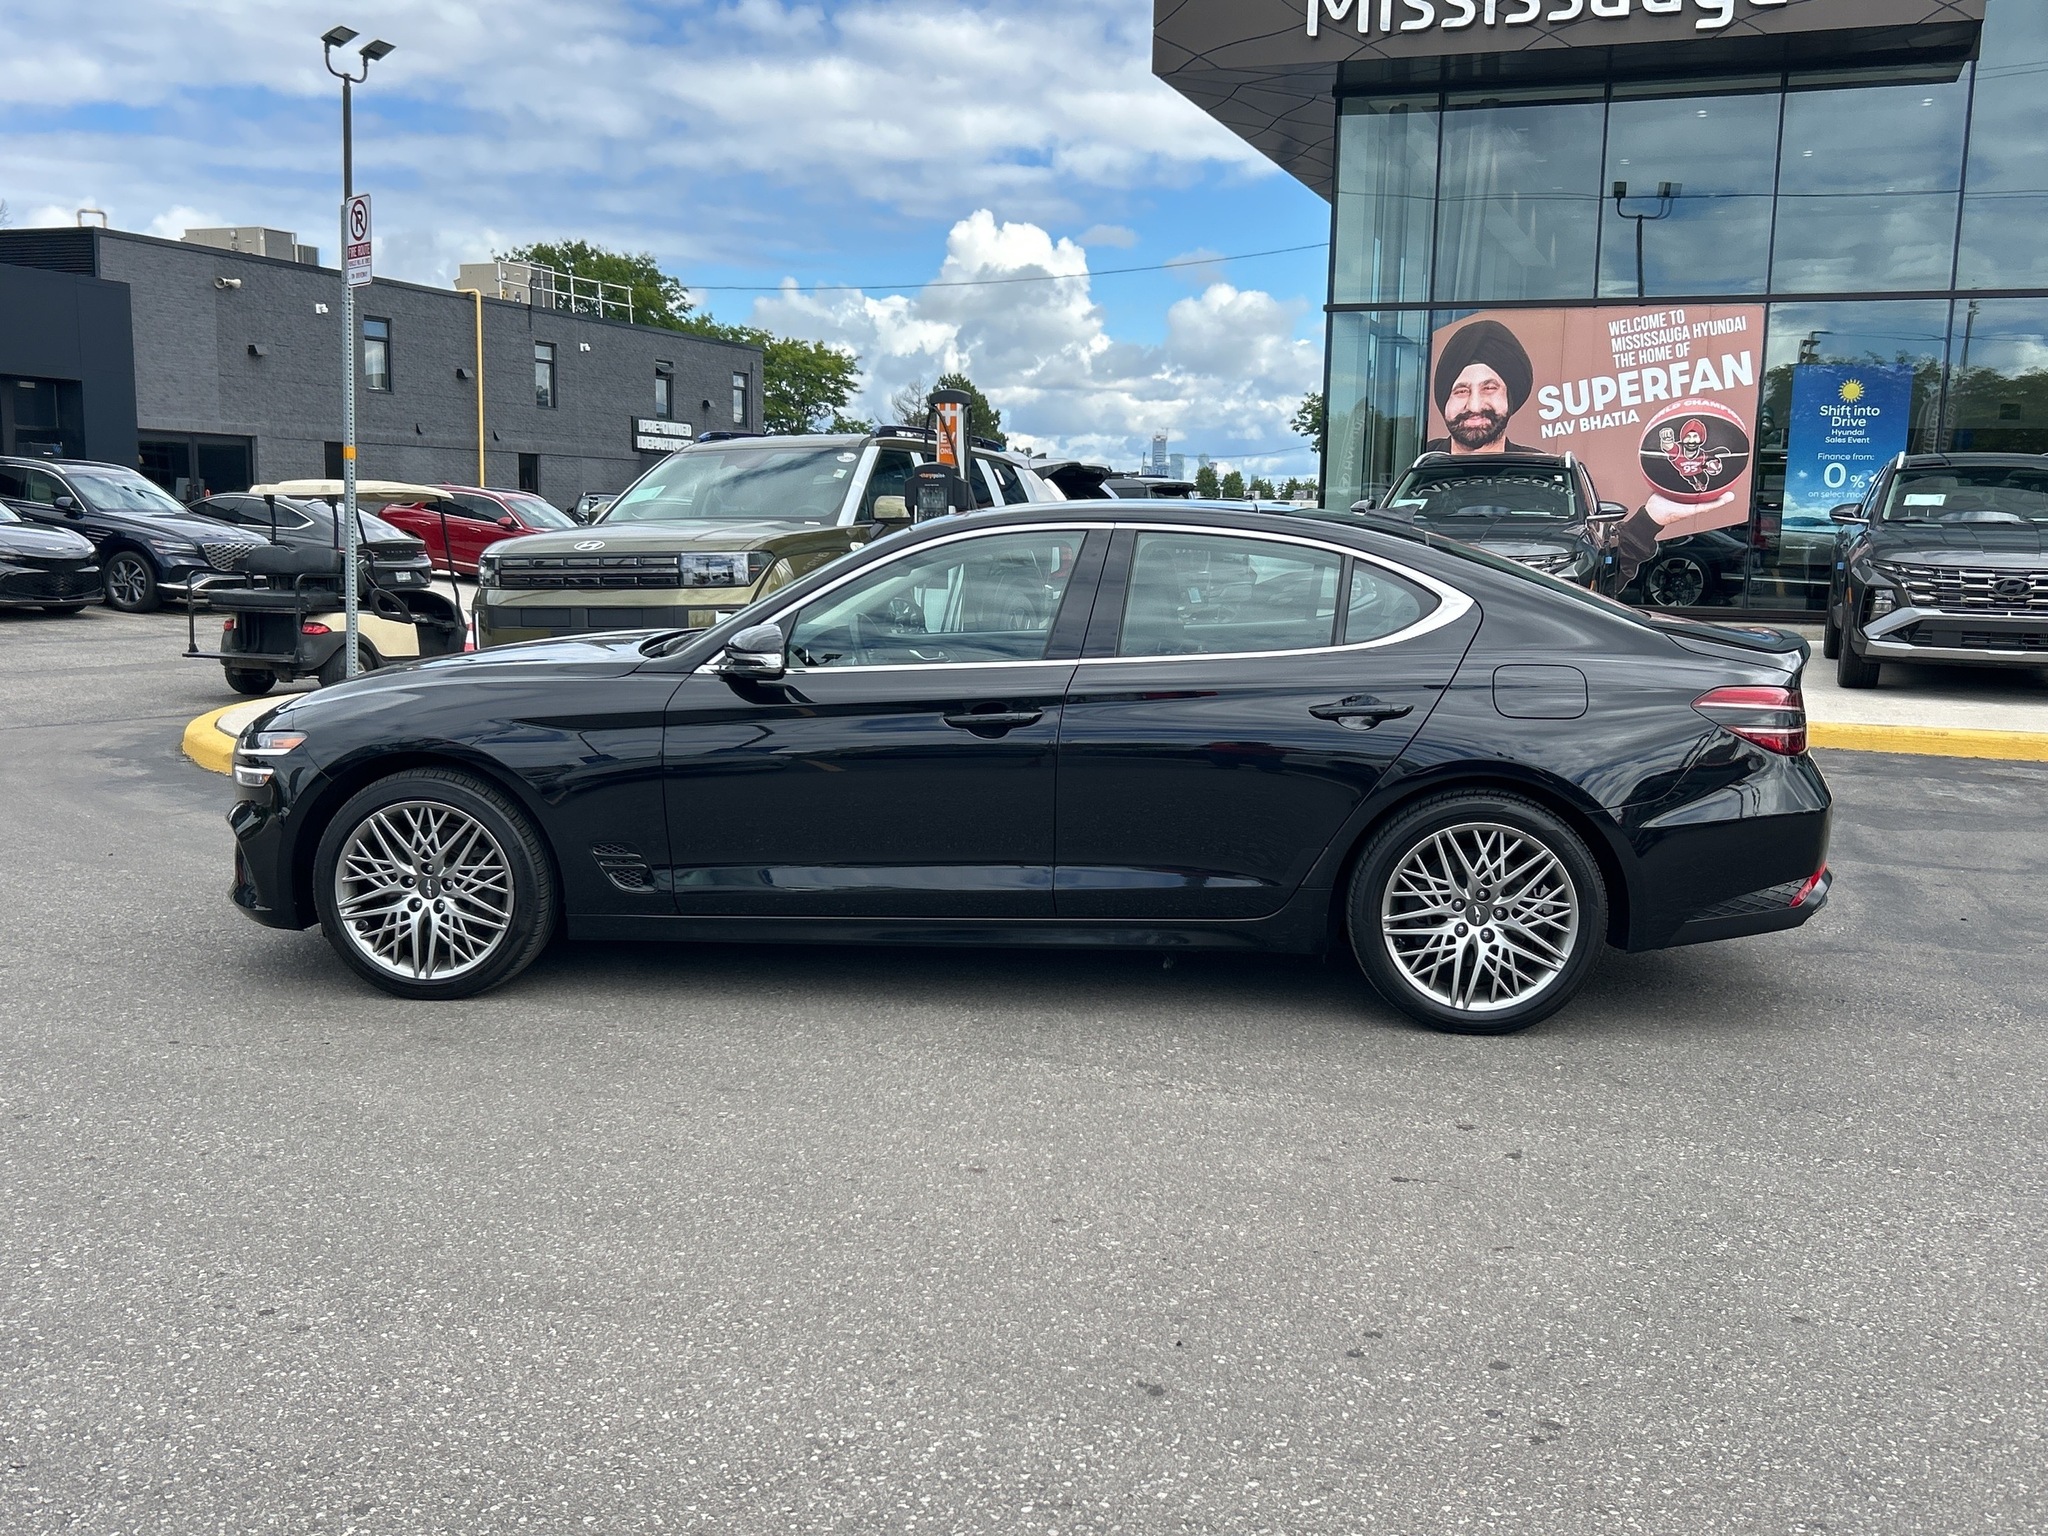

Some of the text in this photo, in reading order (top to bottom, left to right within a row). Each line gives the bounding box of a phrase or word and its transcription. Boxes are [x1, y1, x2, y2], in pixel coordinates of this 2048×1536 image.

[1306, 0, 1788, 37] Mississ
[1608, 309, 1685, 336] WELCOME TO
[1611, 316, 1747, 352] MISSISSAUGA HYUNDAI
[1613, 342, 1690, 368] THE HOME OF
[1537, 351, 1754, 420] SUPERFAN
[1541, 409, 1640, 438] NAV BHATIA
[1819, 405, 1880, 416] Shift into
[1831, 416, 1866, 427] Drive
[636, 435, 694, 452] DEPARTME
[1683, 465, 1698, 473] 95
[1823, 462, 1865, 488] 0 %
